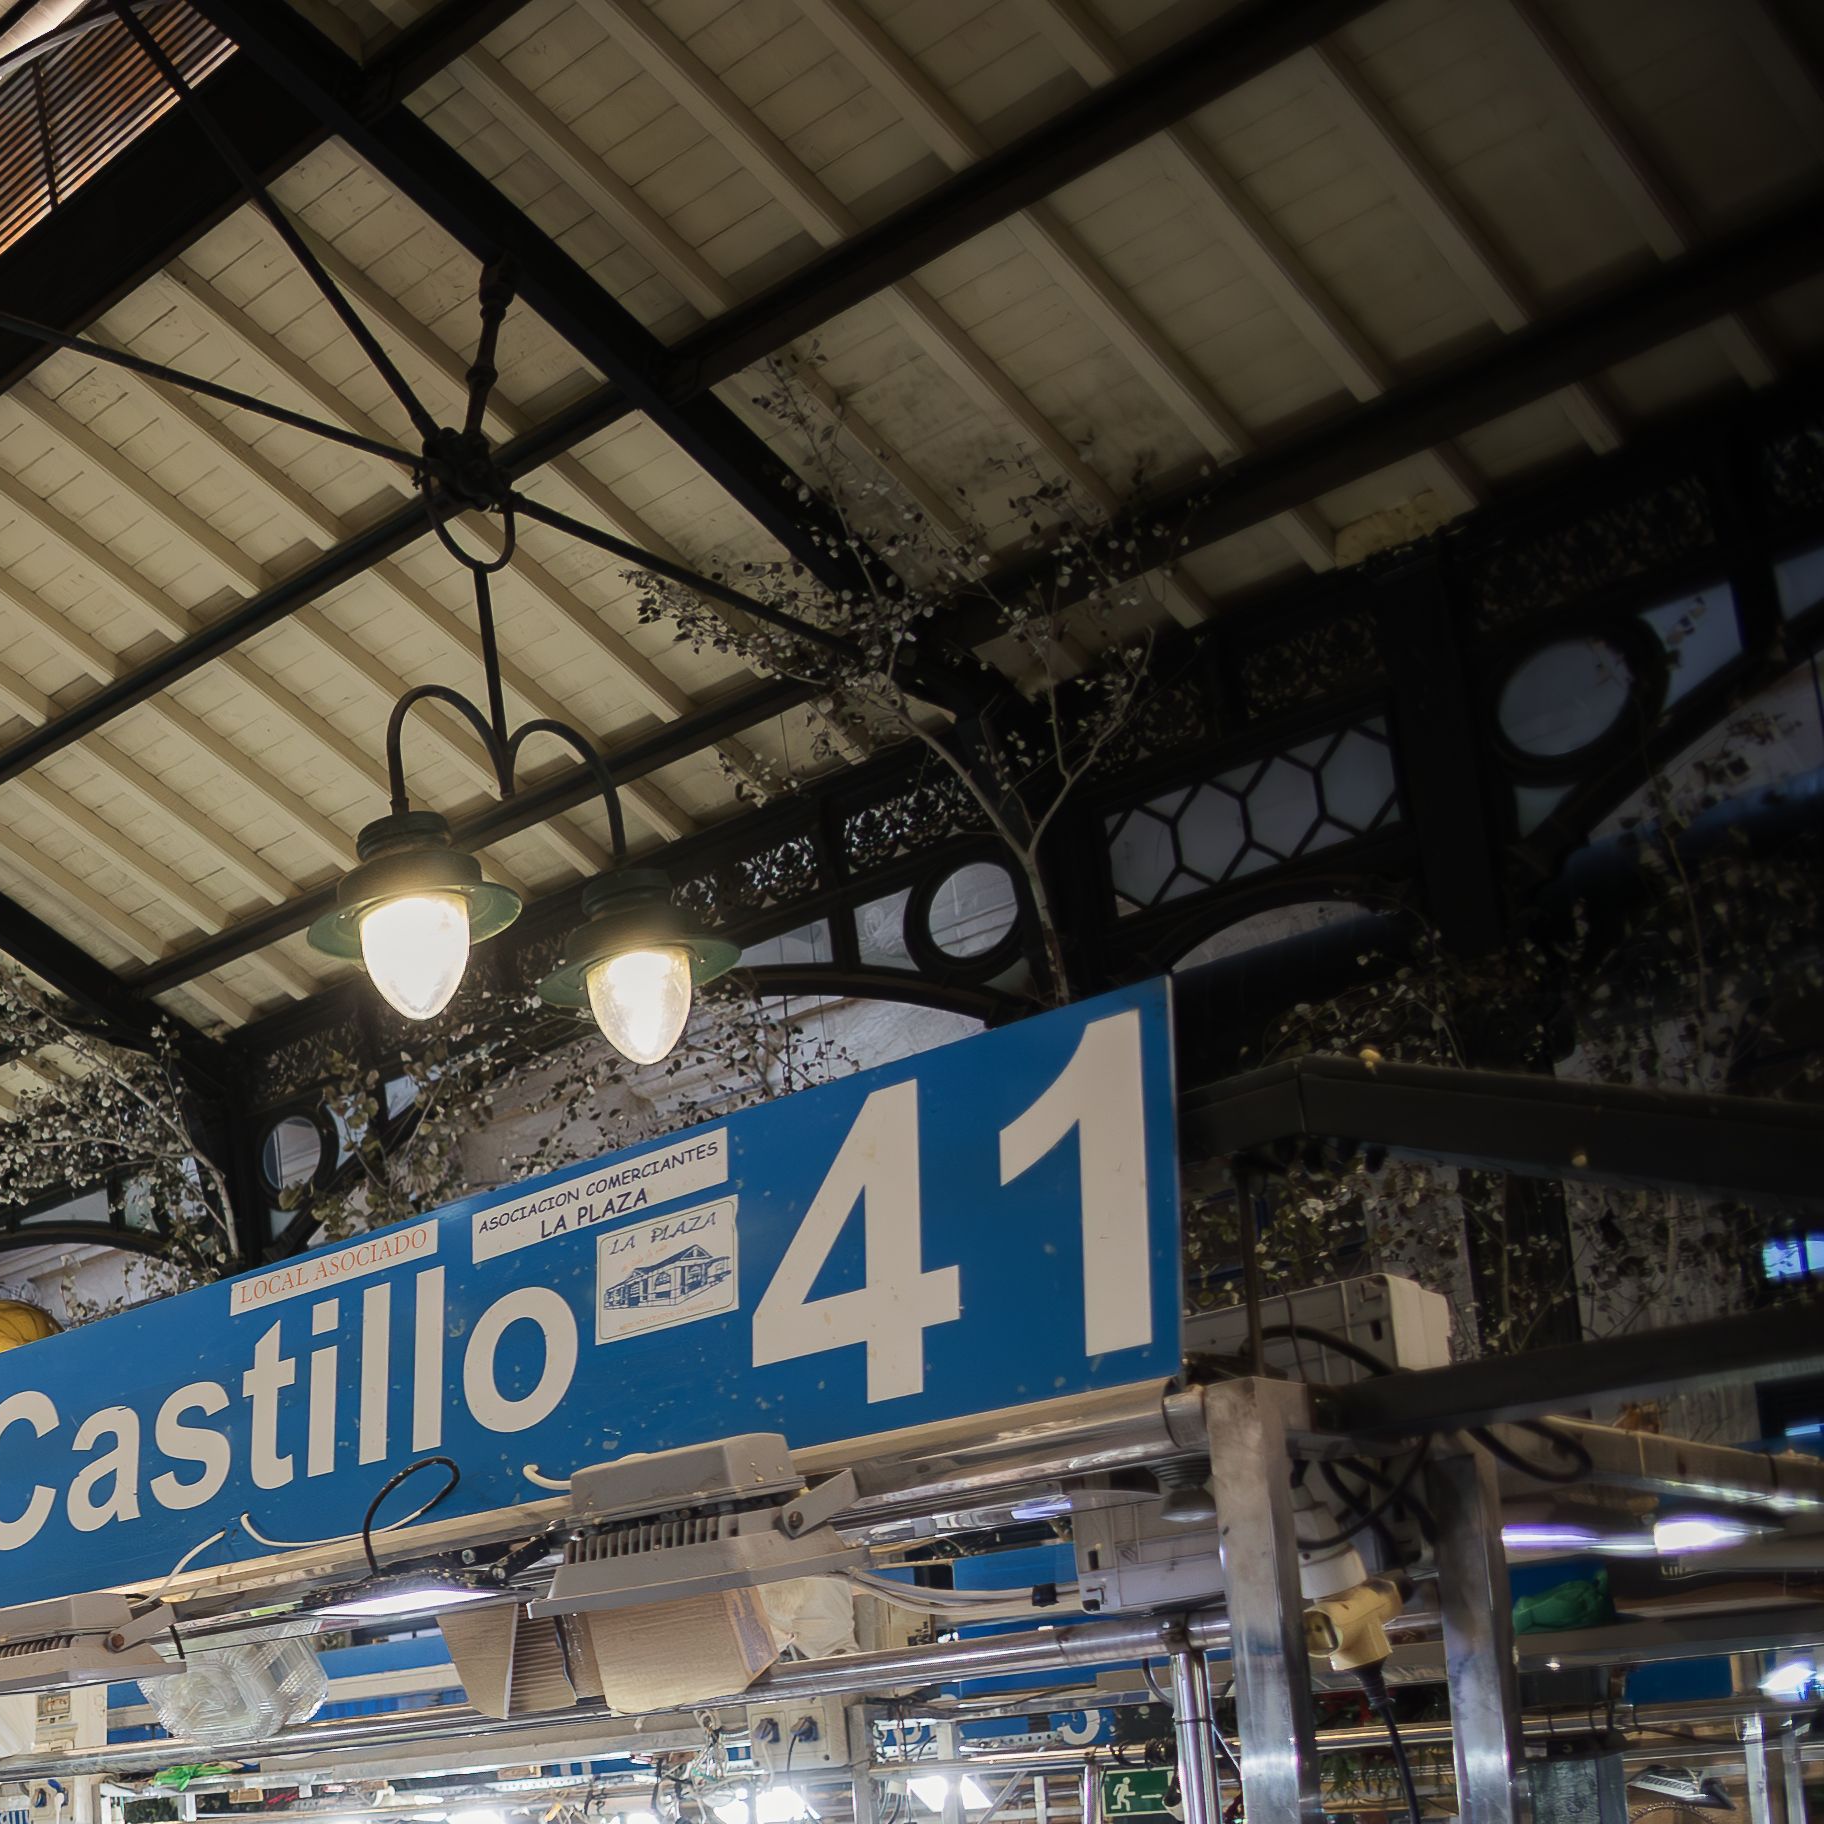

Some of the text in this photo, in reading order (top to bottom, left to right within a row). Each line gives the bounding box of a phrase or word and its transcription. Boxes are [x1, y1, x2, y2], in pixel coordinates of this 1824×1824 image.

[478, 1141, 719, 1235] ASOCIACION COMERCIANTES
[540, 1187, 648, 1240] LA PLAZA
[751, 1008, 1154, 1404] 41
[238, 1229, 428, 1306] LOCAL ASOCIADO
[608, 1211, 717, 1256] LA PLAZA
